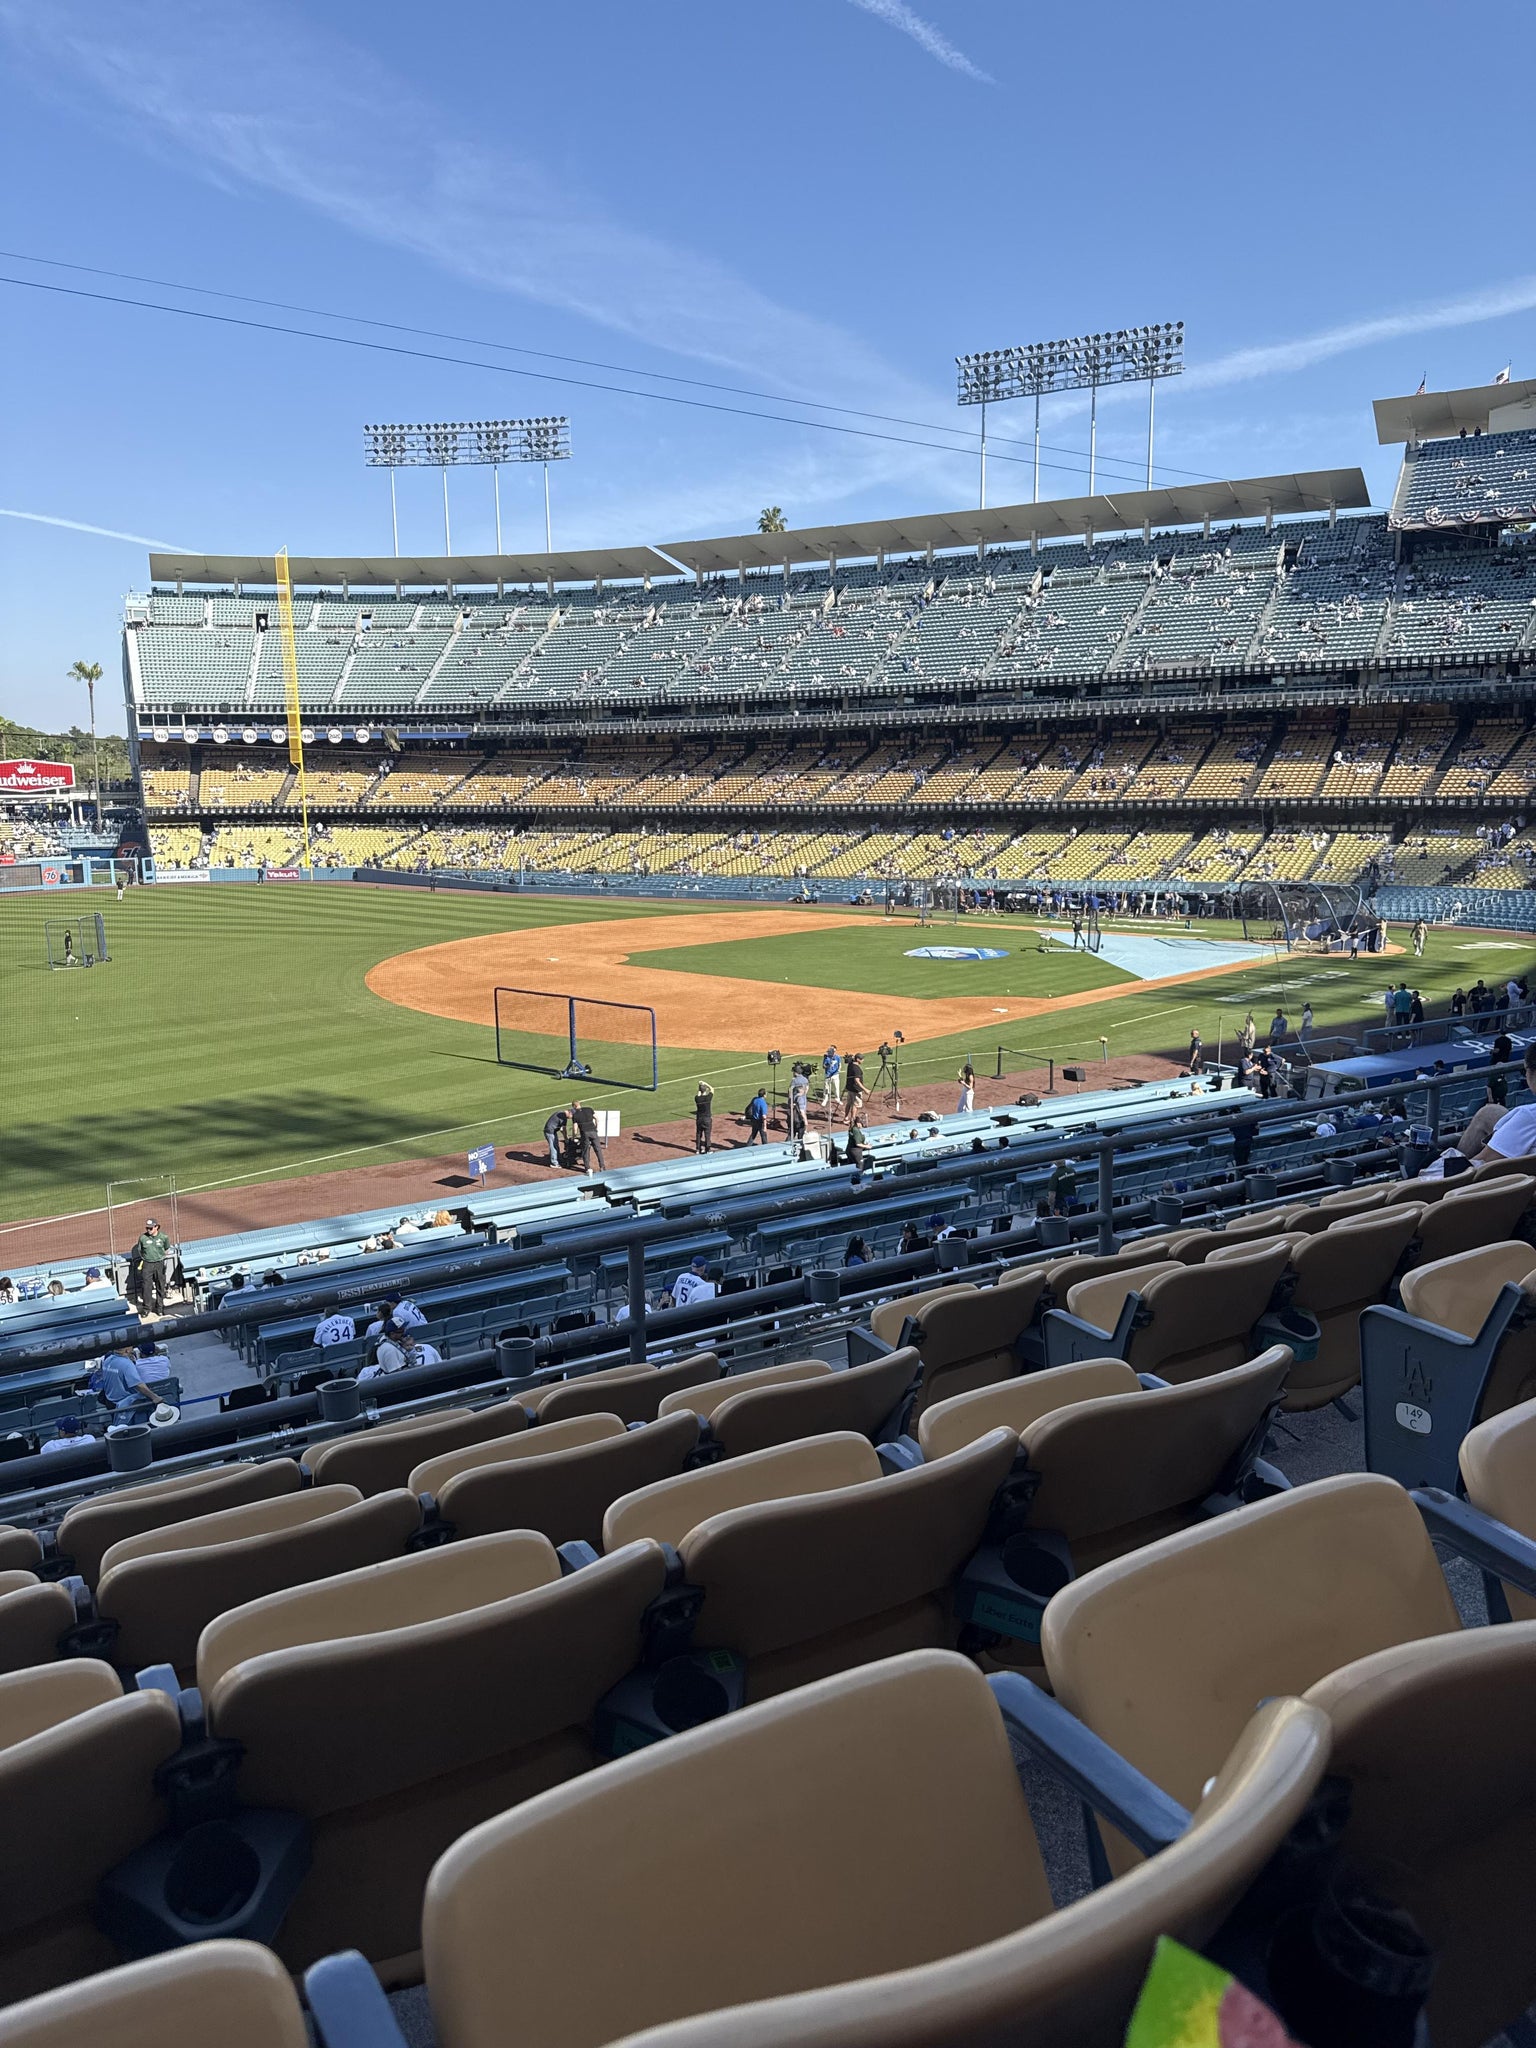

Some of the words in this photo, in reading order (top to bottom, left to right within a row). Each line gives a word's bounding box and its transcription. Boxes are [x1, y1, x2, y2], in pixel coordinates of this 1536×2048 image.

[0, 774, 66, 786] udweiser
[267, 869, 299, 878] Yakult
[468, 1152, 479, 1161] NO
[681, 1287, 688, 1303] 5
[330, 1325, 351, 1343] 34
[1405, 1406, 1423, 1419] 149
[1410, 1419, 1417, 1429] C
